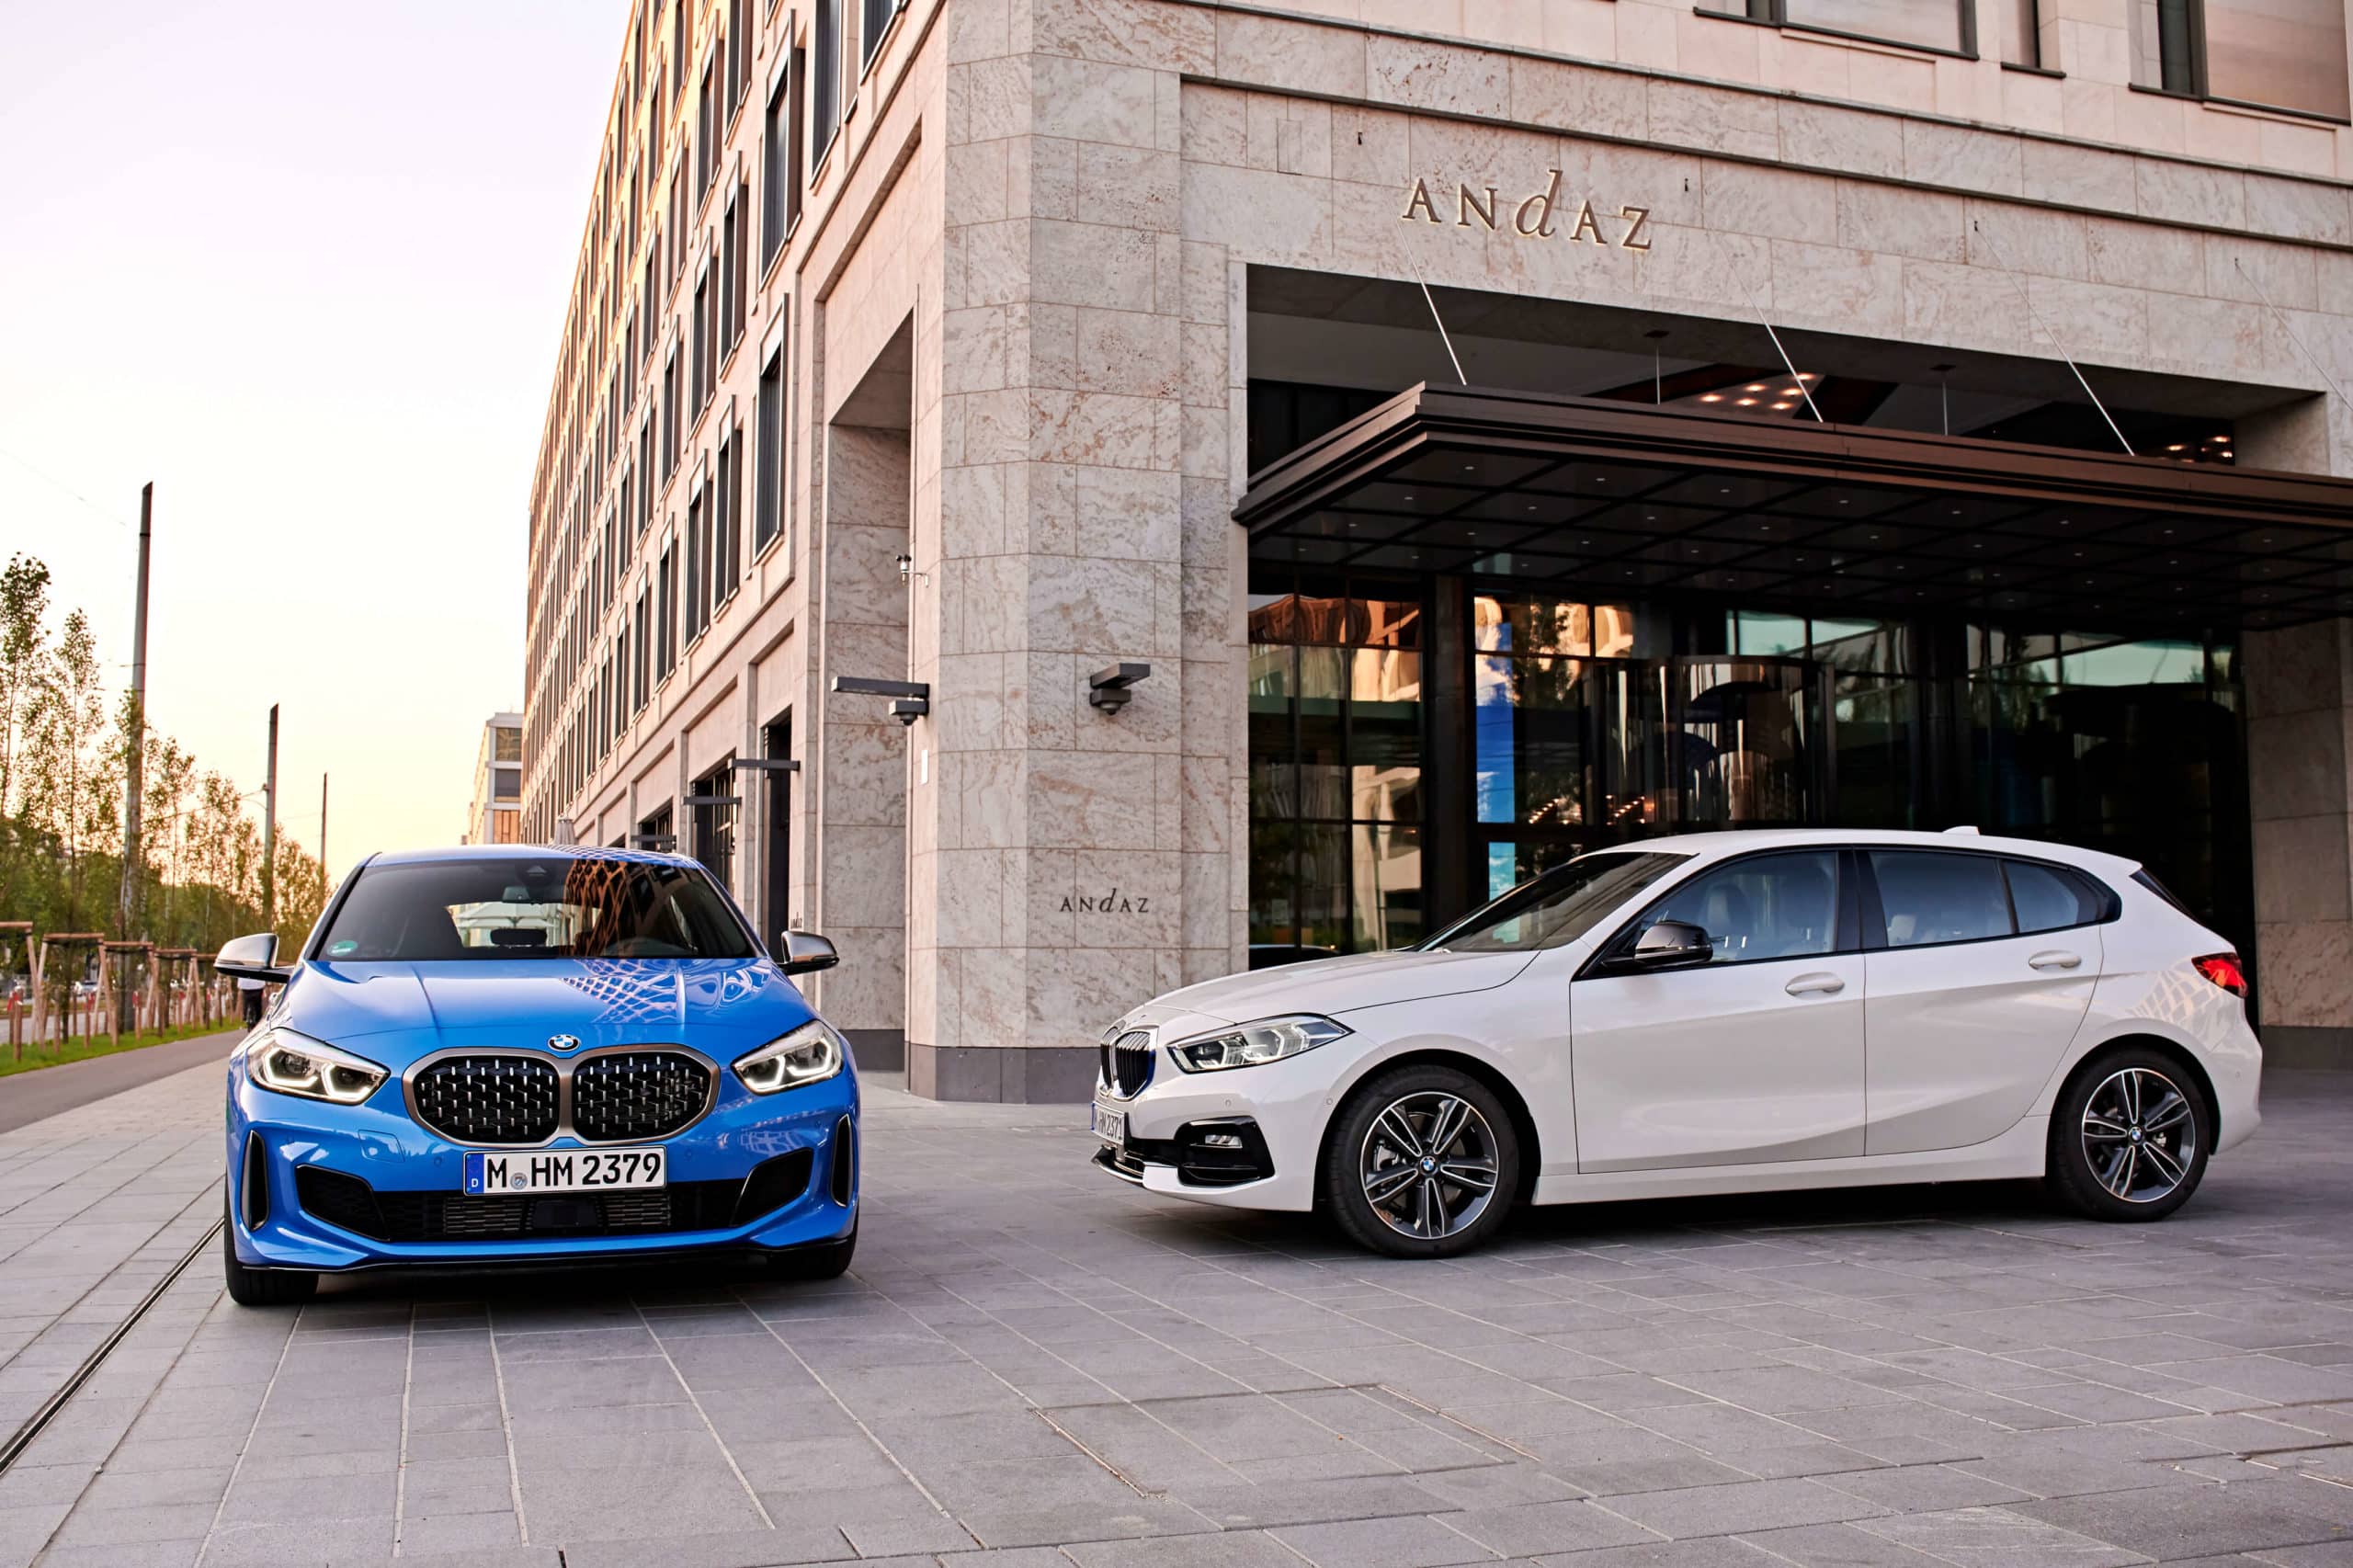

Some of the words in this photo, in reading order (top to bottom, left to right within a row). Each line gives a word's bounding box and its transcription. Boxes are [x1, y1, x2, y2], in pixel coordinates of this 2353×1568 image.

[1402, 169, 1652, 250] ANdAZ
[1059, 887, 1149, 913] ANdAZ
[1107, 1114, 1122, 1140] 2371
[471, 1177, 479, 1187] D
[487, 1157, 507, 1188] M
[530, 1155, 573, 1187] HM
[582, 1153, 661, 1186] 2379
